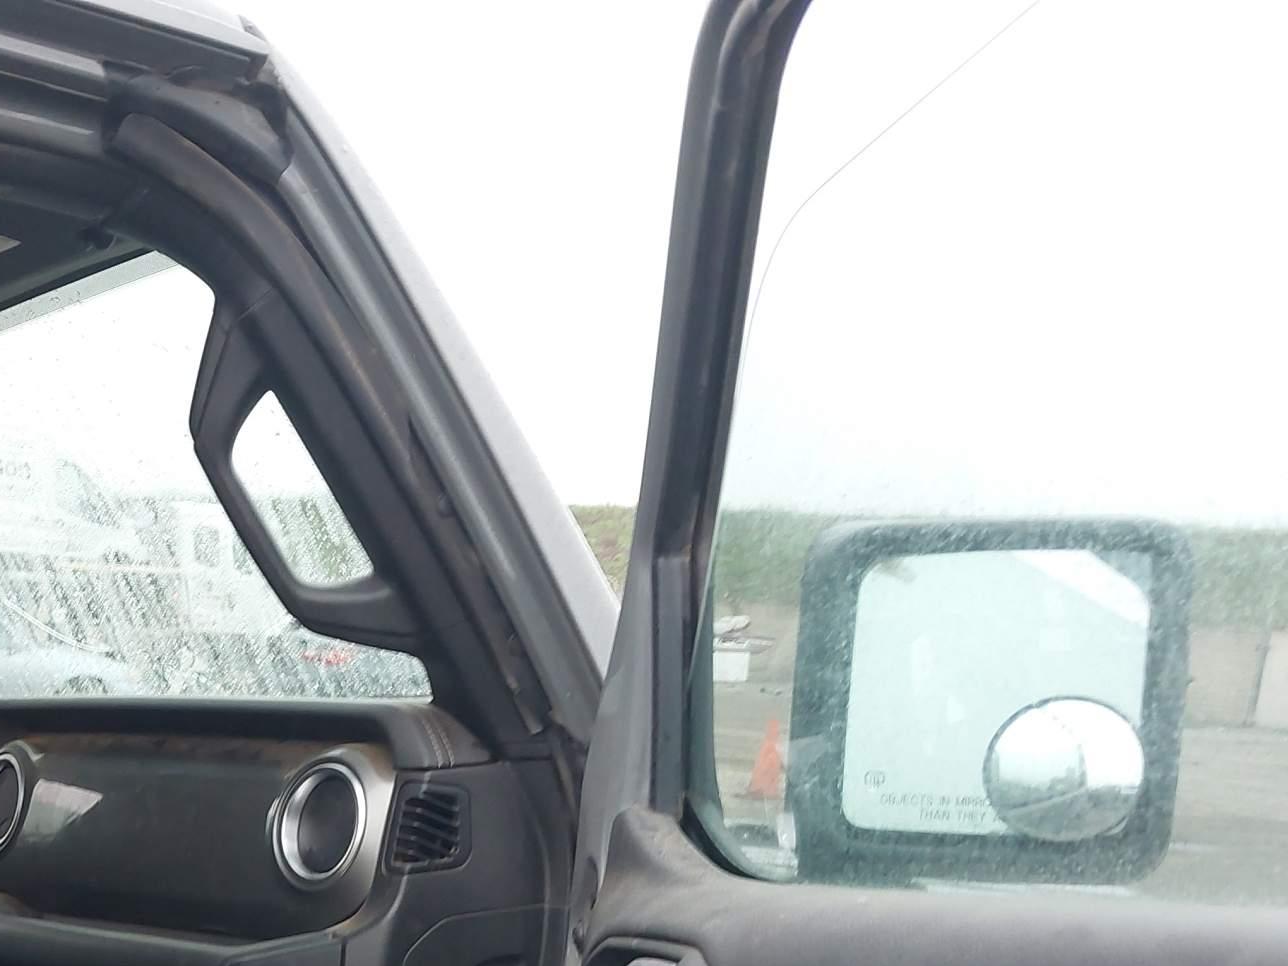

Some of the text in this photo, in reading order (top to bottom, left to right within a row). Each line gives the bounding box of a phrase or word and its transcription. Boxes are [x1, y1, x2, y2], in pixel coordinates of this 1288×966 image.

[879, 792, 933, 807] OBJECTS
[939, 795, 951, 807] IN
[919, 808, 951, 821] THAN
[957, 809, 986, 822] THEY
